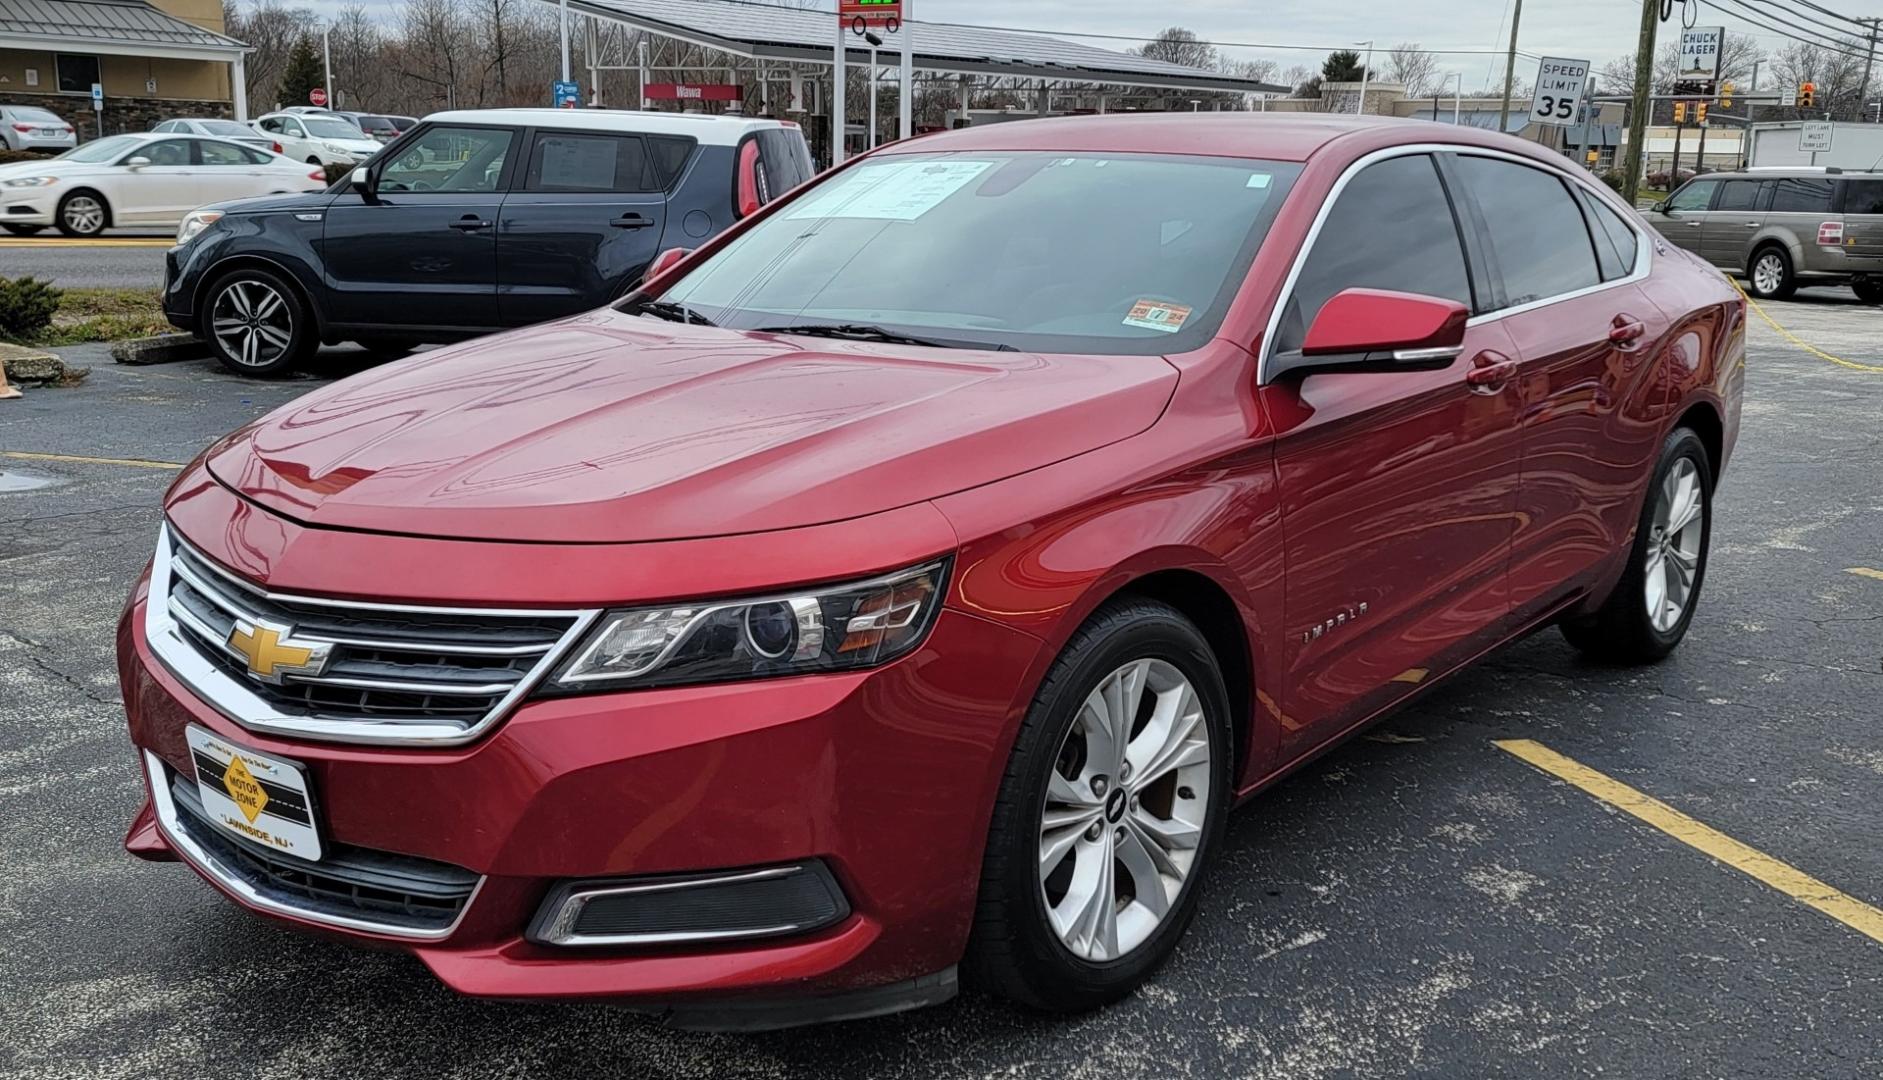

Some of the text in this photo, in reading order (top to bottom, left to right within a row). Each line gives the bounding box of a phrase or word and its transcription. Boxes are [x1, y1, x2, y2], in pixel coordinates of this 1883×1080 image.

[1683, 33, 1718, 43] CHUCK
[1682, 44, 1716, 55] LAGER
[1543, 64, 1585, 77] SPEED
[676, 85, 701, 98] Wawa
[1542, 80, 1579, 92] LIMIT
[311, 93, 327, 101] STOP
[1537, 95, 1574, 119] 35
[1154, 309, 1165, 320] 7
[1304, 602, 1368, 643] IMPALA
[229, 775, 260, 796] MOTOR
[235, 791, 258, 809] ZONE
[274, 836, 289, 848] NJ
